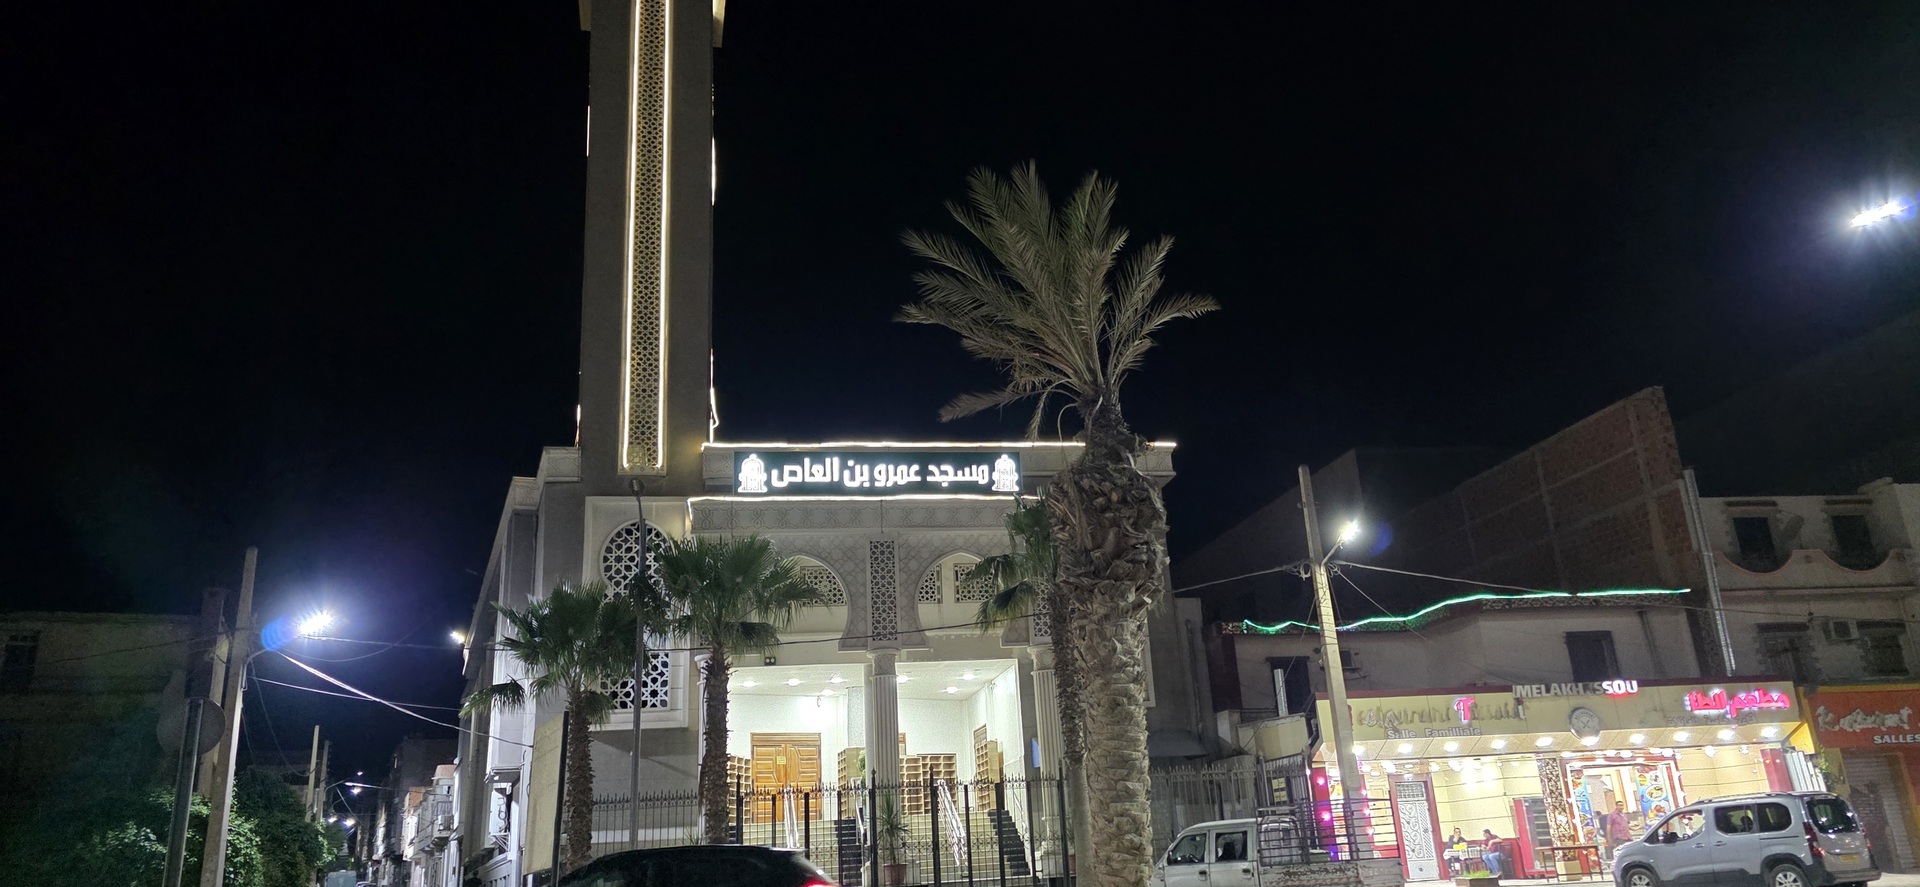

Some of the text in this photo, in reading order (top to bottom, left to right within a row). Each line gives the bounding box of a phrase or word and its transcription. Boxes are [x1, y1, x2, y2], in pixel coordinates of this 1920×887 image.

[771, 456, 989, 488] مسجد عمرو بن العاص
[1513, 680, 1638, 699] MELAKHSSOU
[1873, 733, 1920, 745] SALLES
